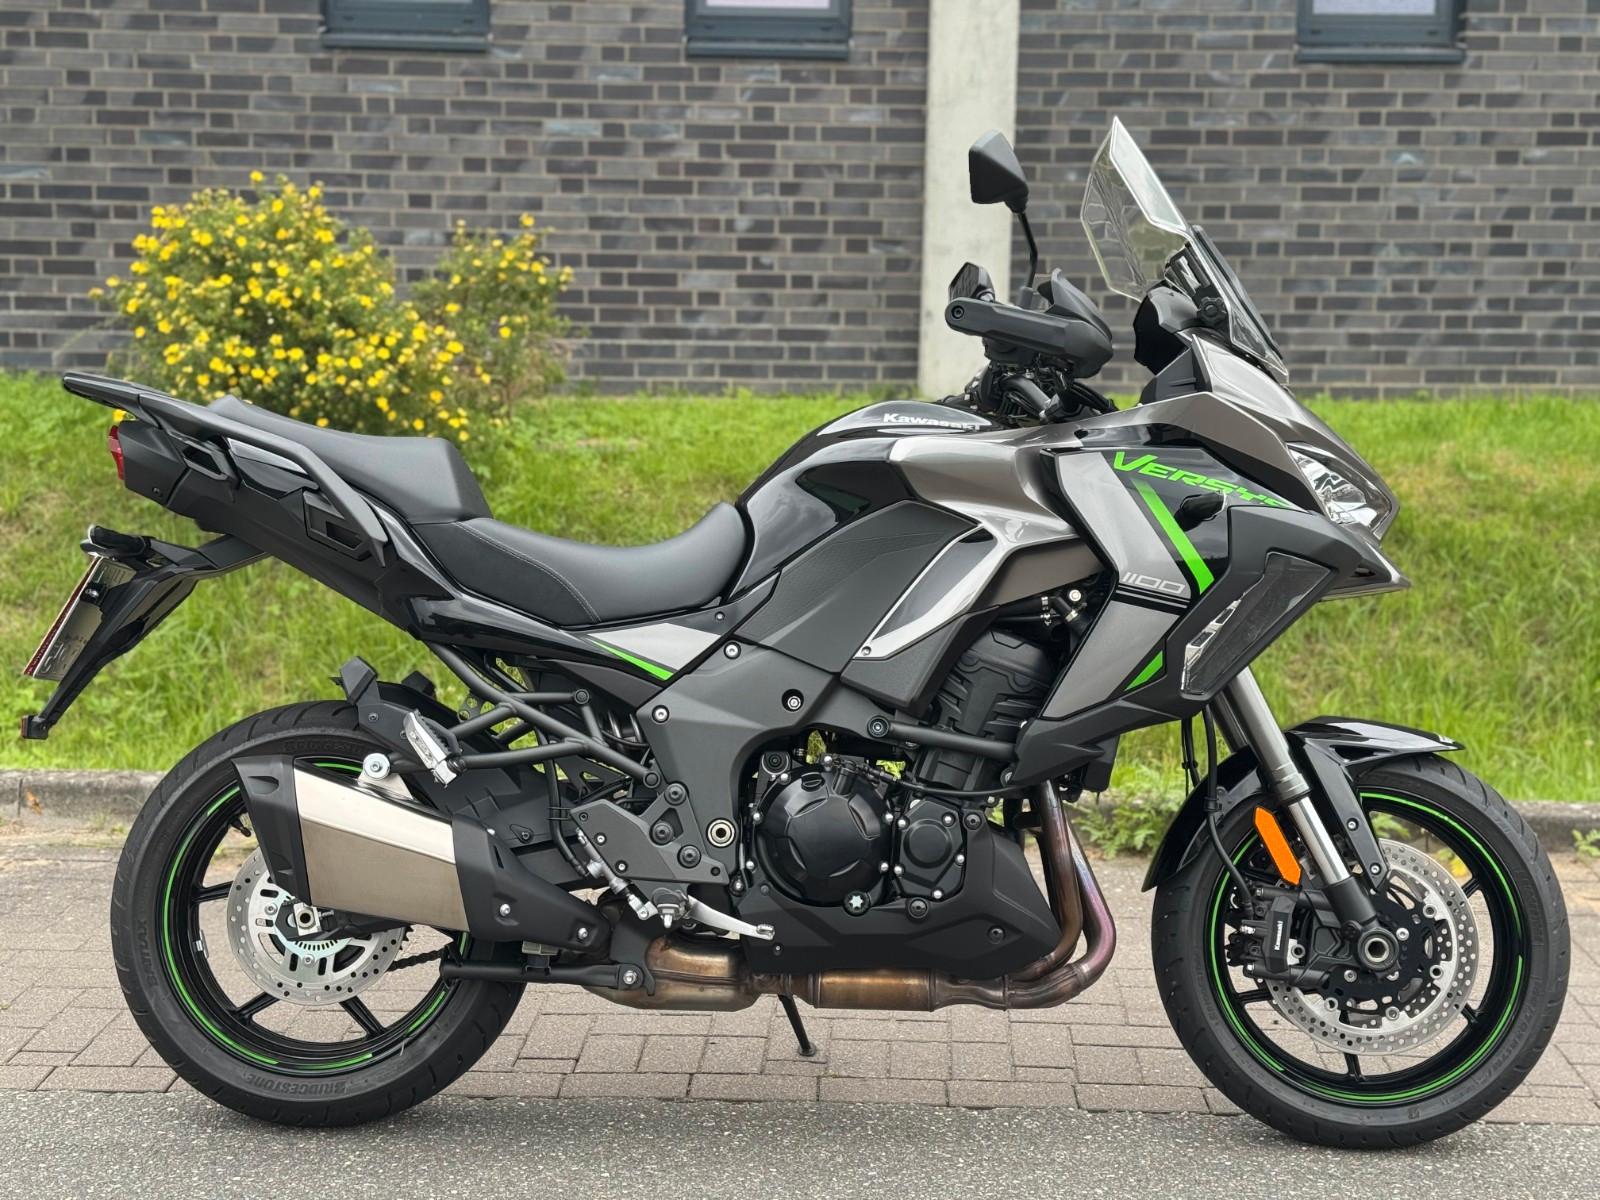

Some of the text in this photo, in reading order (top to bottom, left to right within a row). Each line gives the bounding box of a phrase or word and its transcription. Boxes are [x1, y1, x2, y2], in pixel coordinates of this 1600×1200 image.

[883, 412, 981, 431] Kawasaki
[1113, 451, 1293, 508] VERSYS
[1122, 572, 1186, 594] 1100
[243, 1072, 347, 1095] BRIDGESTONE
